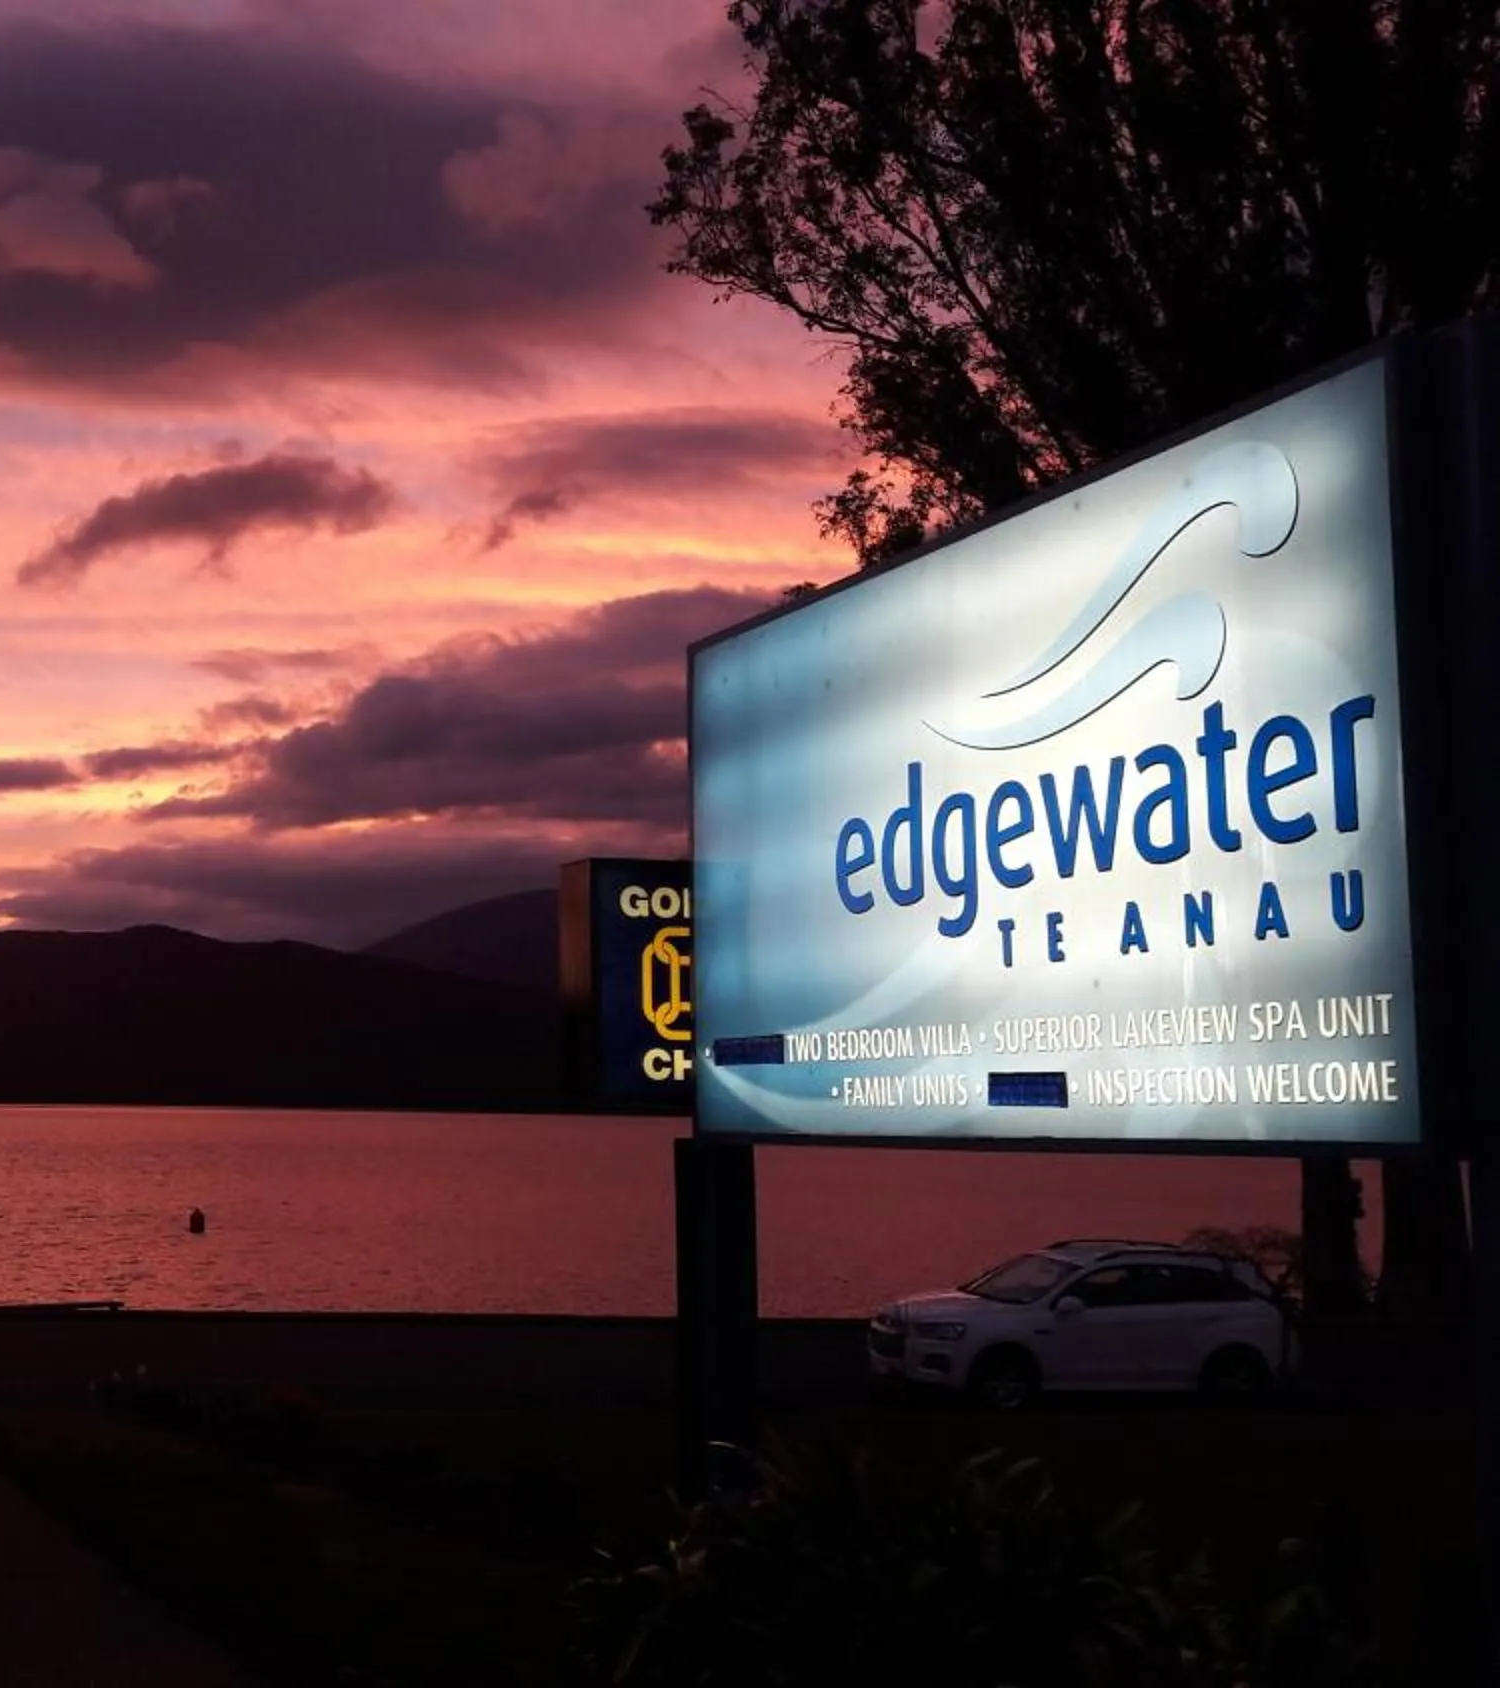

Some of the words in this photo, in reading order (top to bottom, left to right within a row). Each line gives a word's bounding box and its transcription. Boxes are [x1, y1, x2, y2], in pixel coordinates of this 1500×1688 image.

[835, 694, 1376, 938] edgewater
[998, 911, 1066, 968] TE
[1120, 869, 1366, 955] ANAU
[786, 1033, 821, 1064] TWO
[827, 1028, 915, 1061] BEDROOM
[919, 1023, 973, 1056] VILLA
[993, 1014, 1101, 1055] SUPERIOR
[1110, 1005, 1238, 1047] LAKEVIEW
[1249, 1000, 1308, 1042] SPA
[1318, 993, 1393, 1038] UNIT
[843, 1076, 907, 1107] FAMILY
[912, 1074, 968, 1105] UNITS
[1087, 1068, 1238, 1105] INSPECTION
[1246, 1061, 1399, 1103] WELCOME
